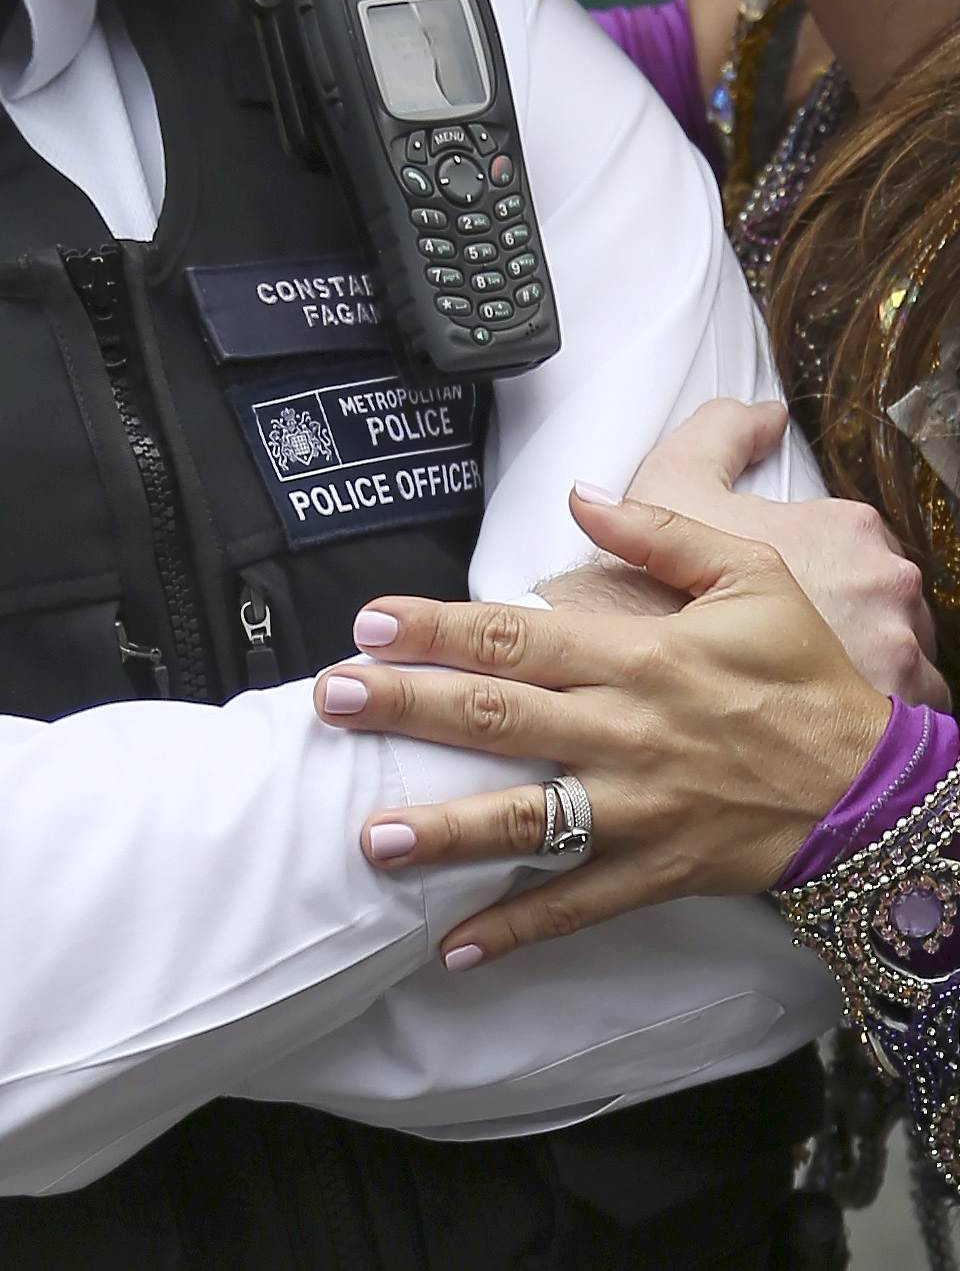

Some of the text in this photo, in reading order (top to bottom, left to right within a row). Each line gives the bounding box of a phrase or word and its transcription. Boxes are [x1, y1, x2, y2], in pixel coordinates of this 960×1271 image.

[434, 131, 465, 145] MENU
[421, 210, 429, 224] 1
[498, 203, 508, 217] 3
[462, 216, 473, 230] 2
[424, 239, 434, 253] 4
[504, 232, 514, 246] 6
[468, 246, 479, 260] 5
[431, 269, 441, 282] 7
[511, 262, 521, 275] 9
[476, 275, 486, 289] 8
[483, 305, 494, 318] 0
[338, 385, 462, 417] METROPOLITAN
[366, 407, 454, 446] POLICE
[288, 459, 482, 521] POLICE OFFICER
